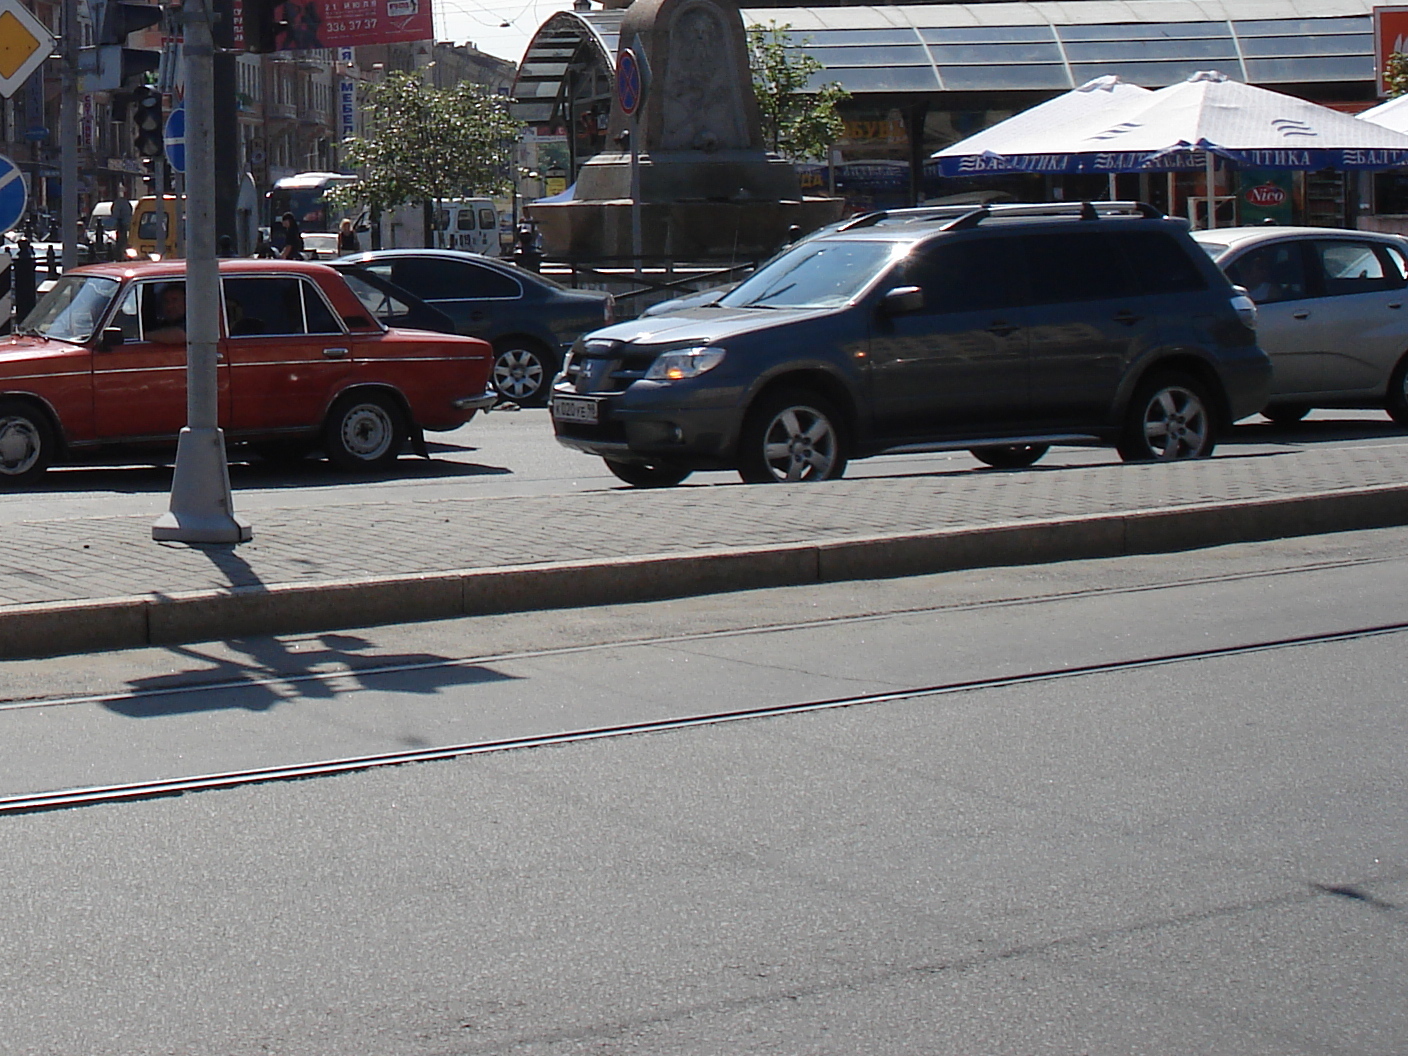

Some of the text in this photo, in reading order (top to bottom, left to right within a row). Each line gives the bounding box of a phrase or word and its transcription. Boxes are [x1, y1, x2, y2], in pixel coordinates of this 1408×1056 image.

[326, 18, 378, 33] 336 37 37
[340, 82, 354, 141] МЕБЕЛ
[1251, 188, 1284, 202] Nico
